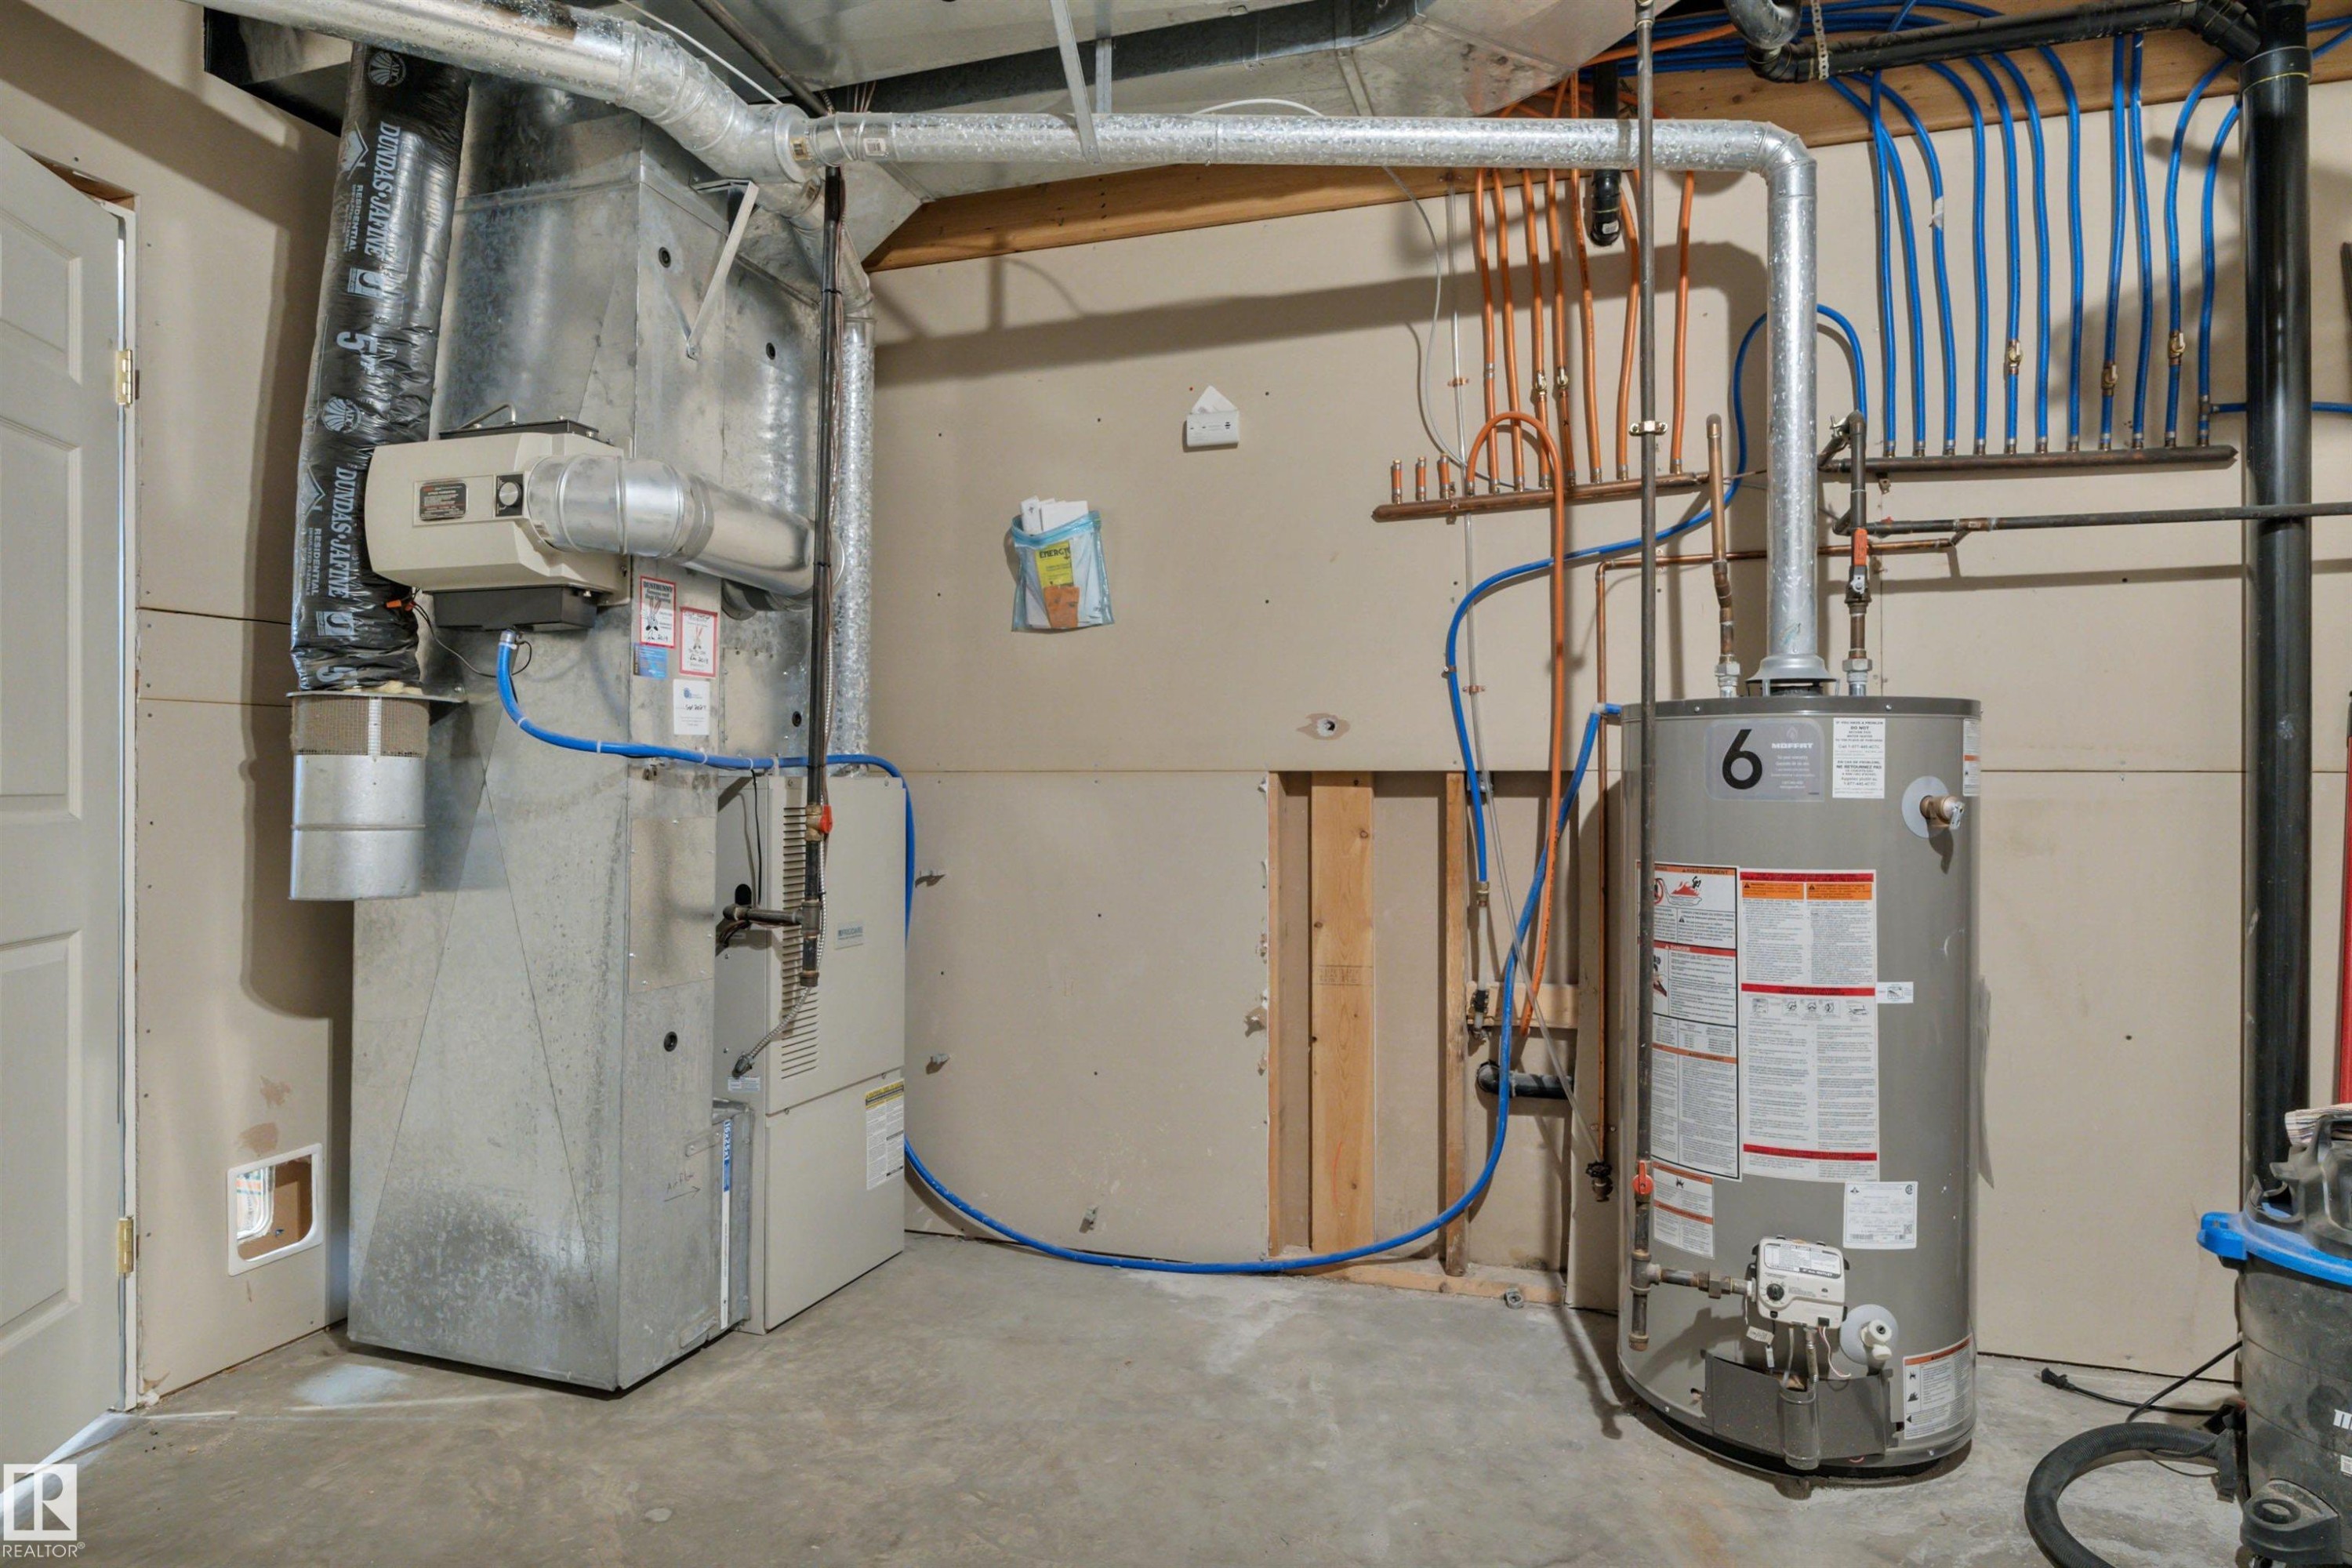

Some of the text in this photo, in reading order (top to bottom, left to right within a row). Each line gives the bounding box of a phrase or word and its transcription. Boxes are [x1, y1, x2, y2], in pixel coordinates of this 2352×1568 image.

[348, 184, 364, 252] RESIDENTIAL
[311, 528, 322, 596] RESIDENTIAL
[1722, 728, 1762, 789] 6
